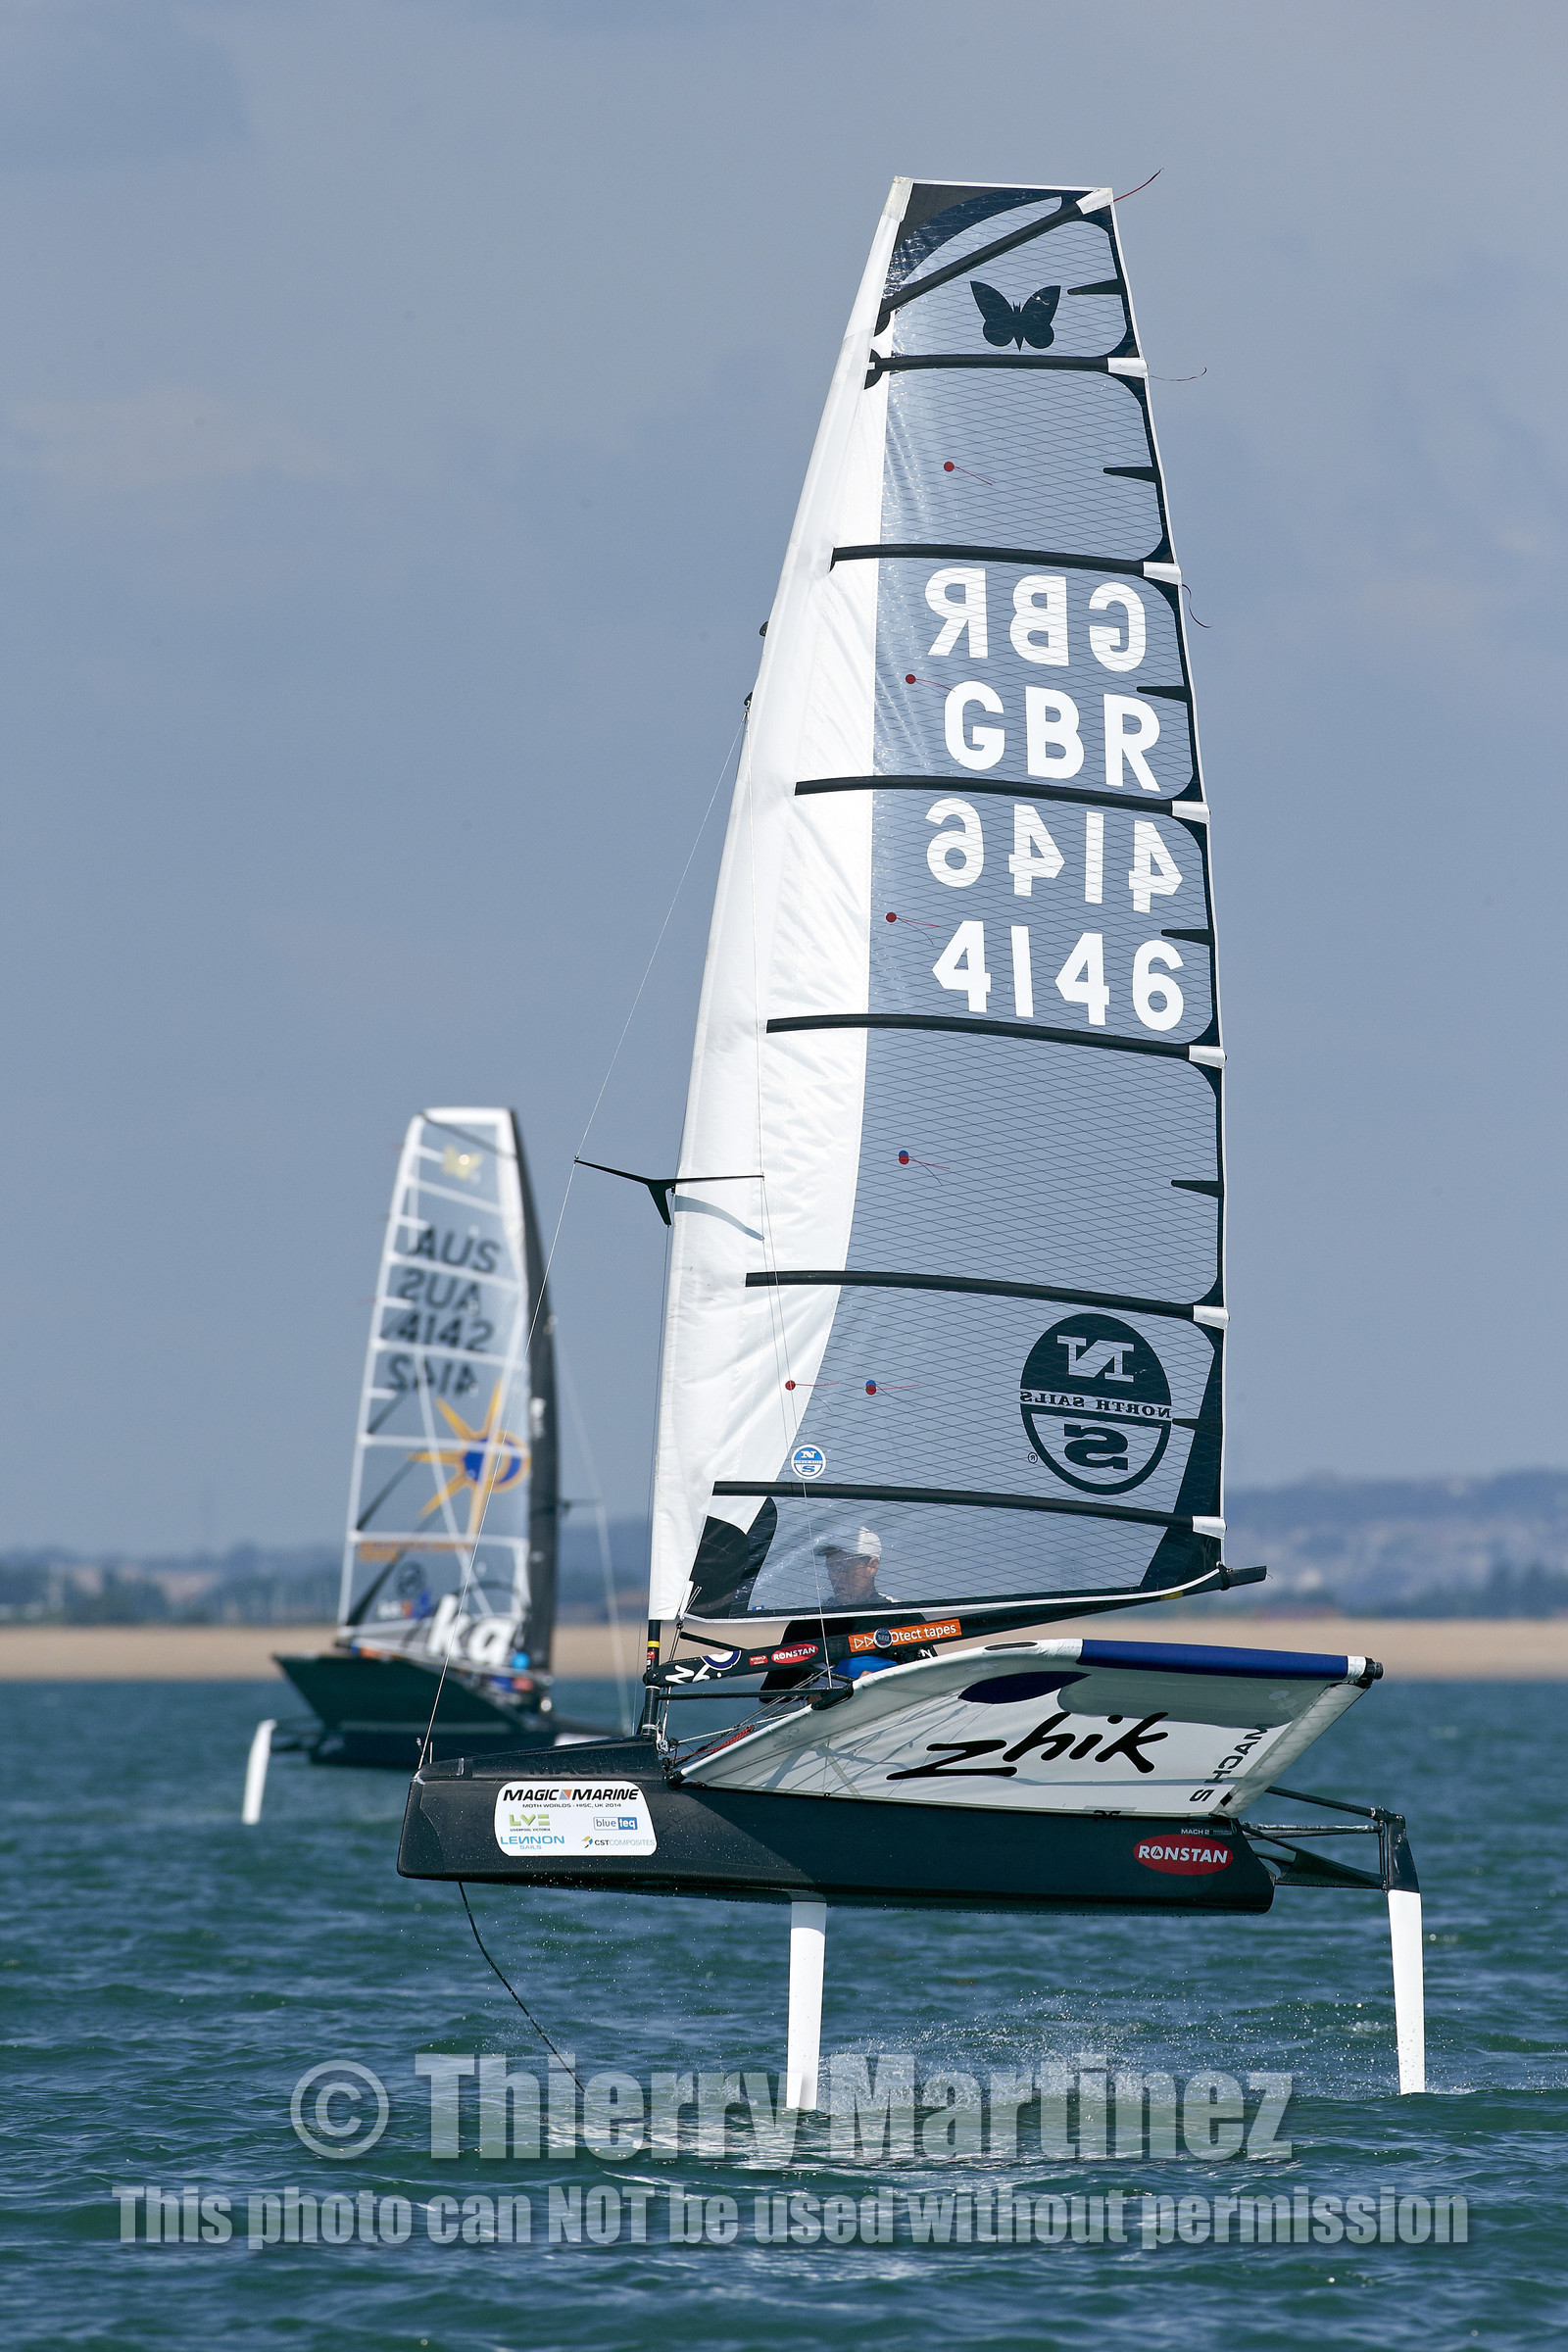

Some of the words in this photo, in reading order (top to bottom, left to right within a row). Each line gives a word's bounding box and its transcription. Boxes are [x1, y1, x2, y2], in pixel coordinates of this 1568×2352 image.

[945, 681, 1160, 791] GBR
[932, 920, 1184, 1031] 4146
[410, 1226, 501, 1274] AUS
[397, 1312, 494, 1352] 4142
[772, 1646, 816, 1661] RONSTAN
[890, 1628, 922, 1643] Otect
[923, 1624, 956, 1640] tapes
[886, 1711, 1169, 1781] zhik
[503, 1788, 560, 1801] MAGIC
[571, 1788, 639, 1800] MARINE
[1138, 1845, 1228, 1864] RONSTAN
